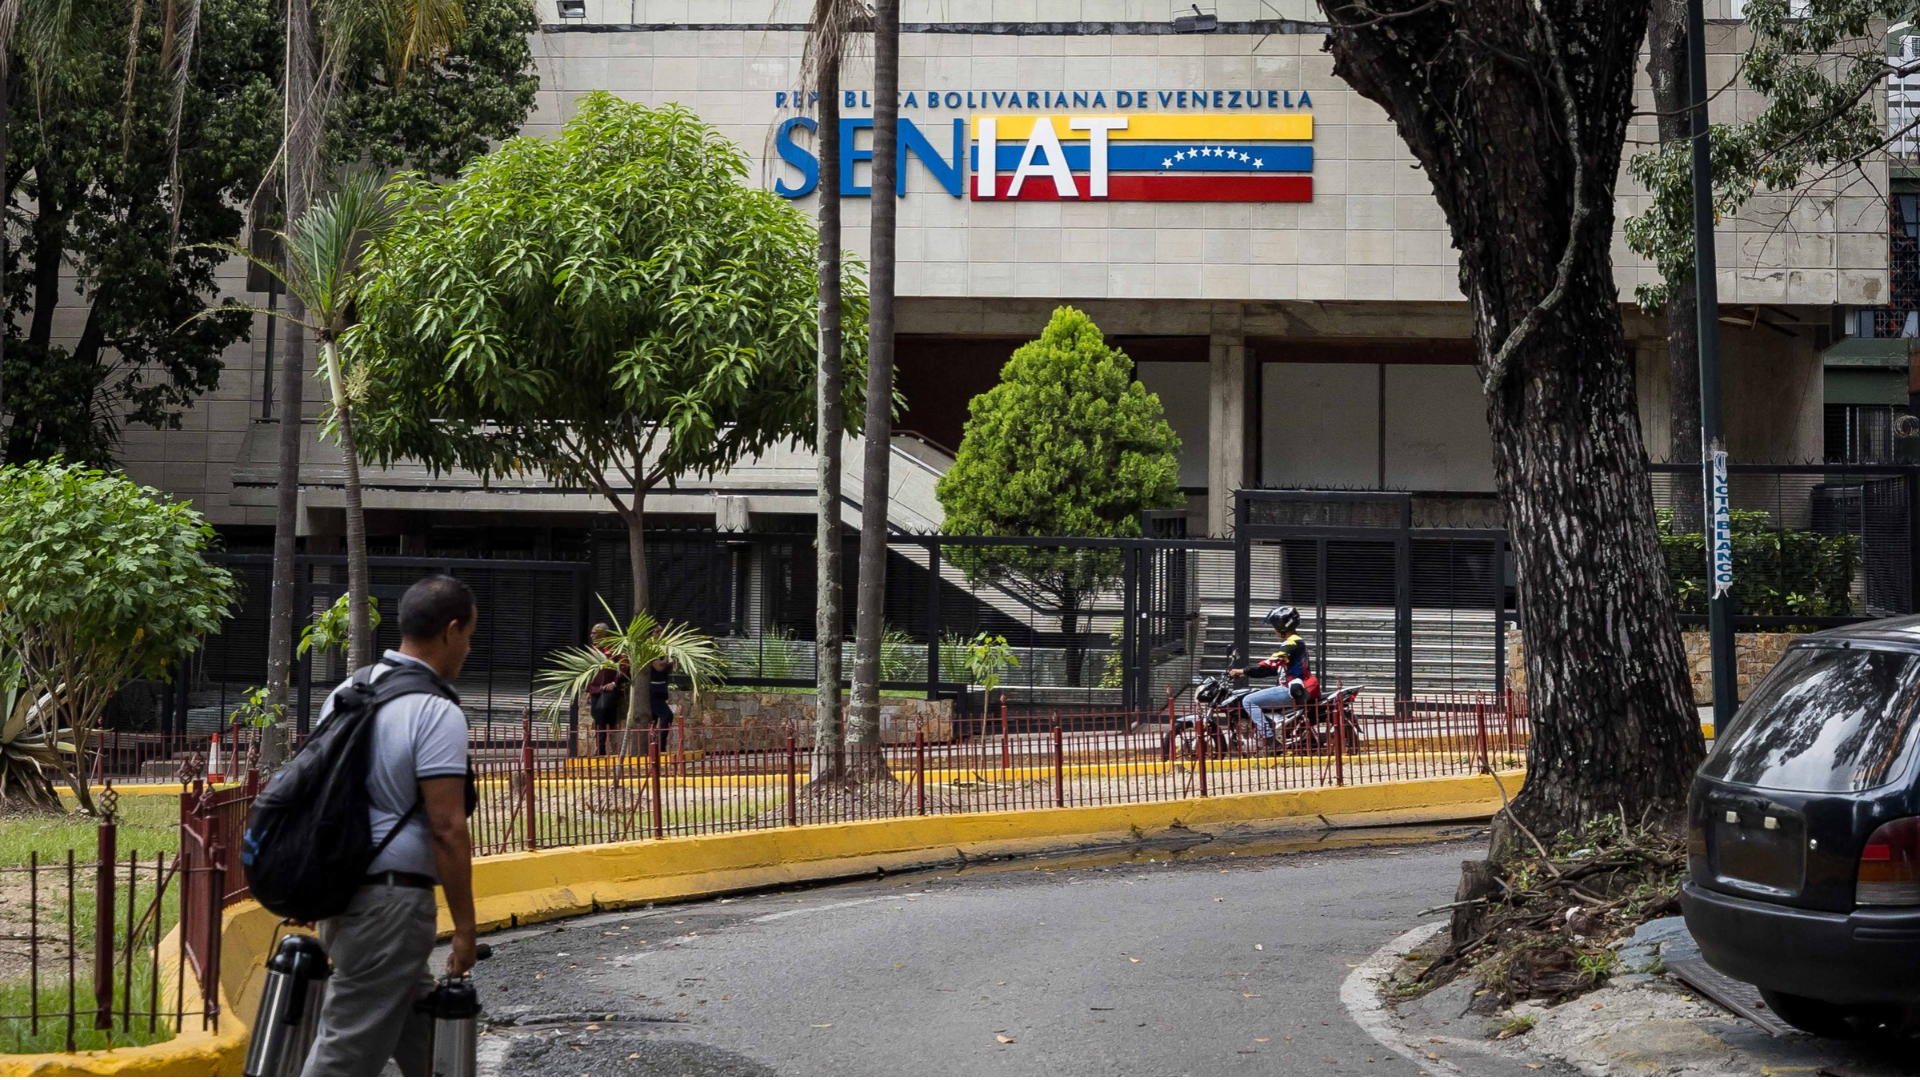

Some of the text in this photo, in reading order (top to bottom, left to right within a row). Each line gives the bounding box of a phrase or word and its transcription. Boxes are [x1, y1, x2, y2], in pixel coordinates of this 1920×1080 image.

[775, 90, 1313, 109] REPBLA BOLIVARIANA DE VENEZUELA
[775, 116, 1129, 198] SENIAT
[1715, 475, 1732, 582] VOTA BLANCO
